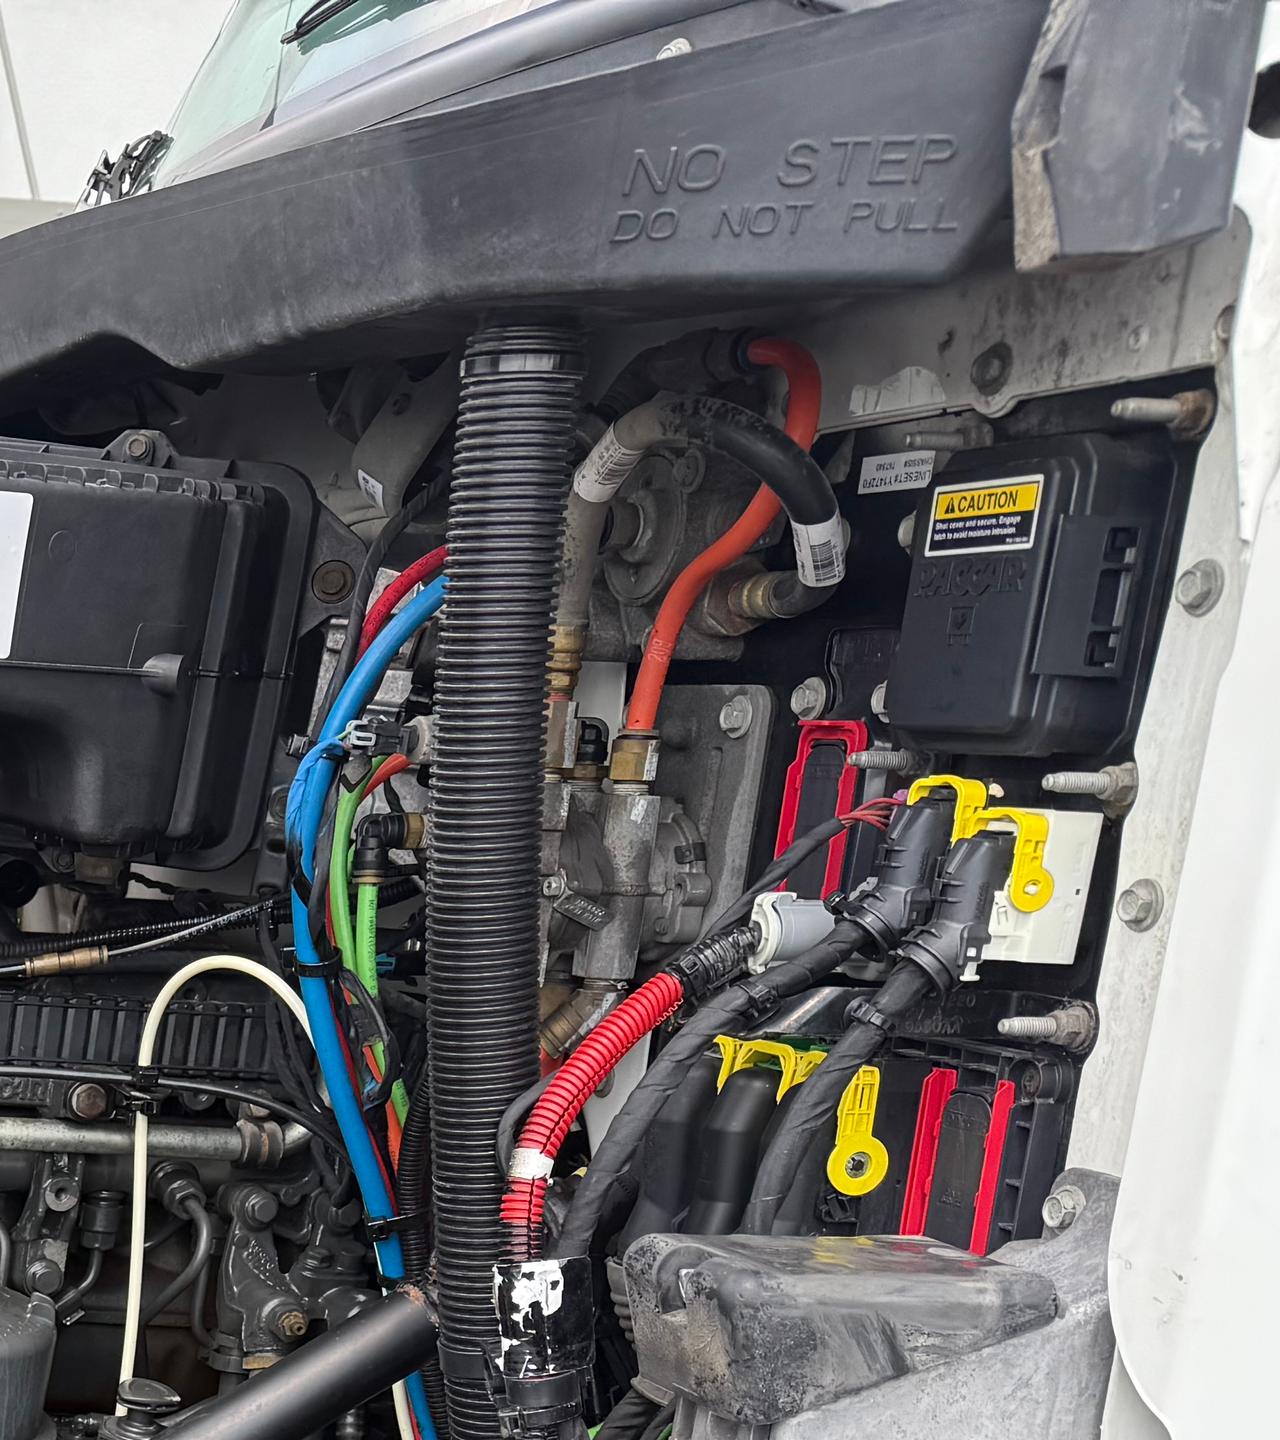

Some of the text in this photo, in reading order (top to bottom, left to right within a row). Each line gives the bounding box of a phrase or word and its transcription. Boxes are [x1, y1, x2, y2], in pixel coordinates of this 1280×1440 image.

[622, 134, 958, 196] NO STEP
[610, 199, 958, 243] DO NOT PULL
[894, 470, 932, 484] LINESET#
[958, 490, 1018, 512] CAUTION
[914, 556, 1026, 597] PACCAR
